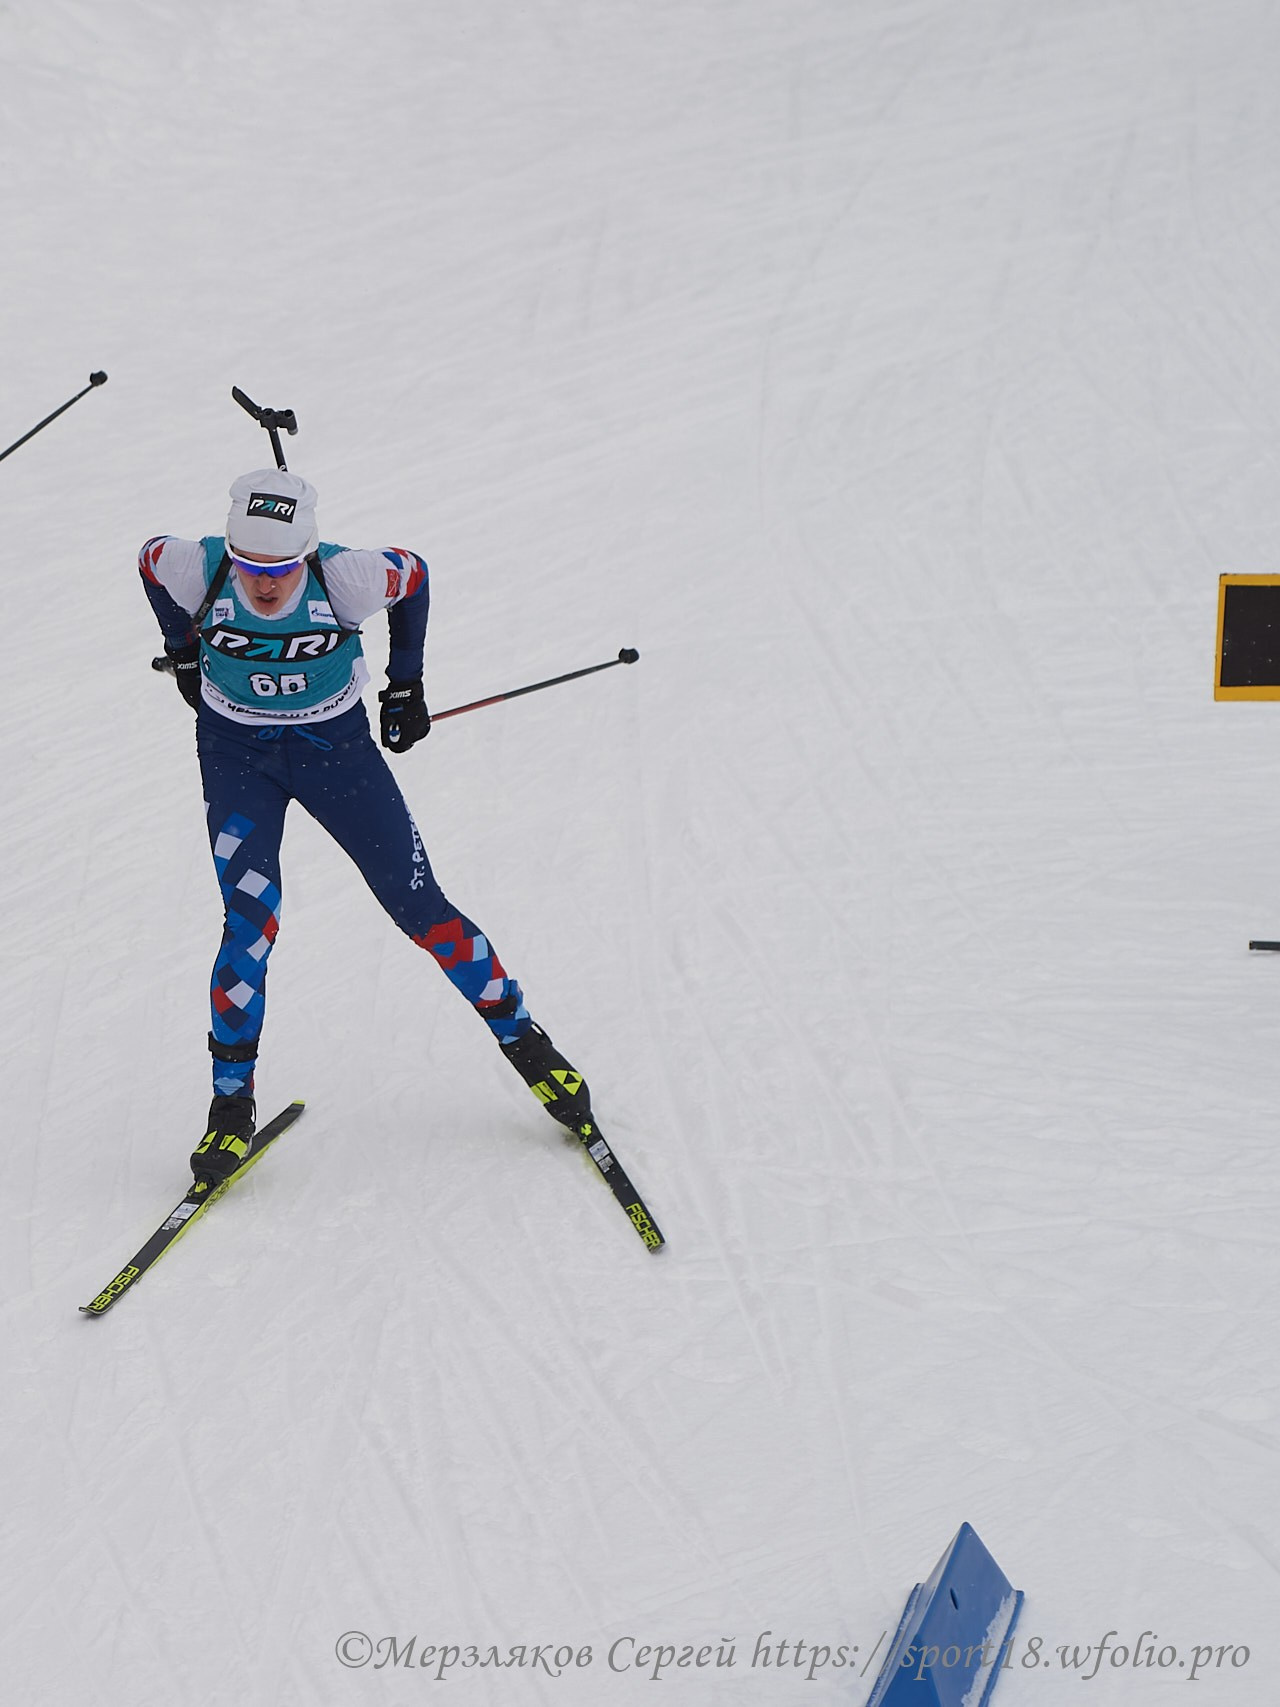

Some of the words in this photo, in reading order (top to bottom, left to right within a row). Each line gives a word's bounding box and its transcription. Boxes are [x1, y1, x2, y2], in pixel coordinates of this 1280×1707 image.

[249, 499, 295, 516] PARI
[210, 630, 339, 659] PARI
[625, 1203, 661, 1250] FISCHER
[86, 1265, 140, 1310] FISCHER
